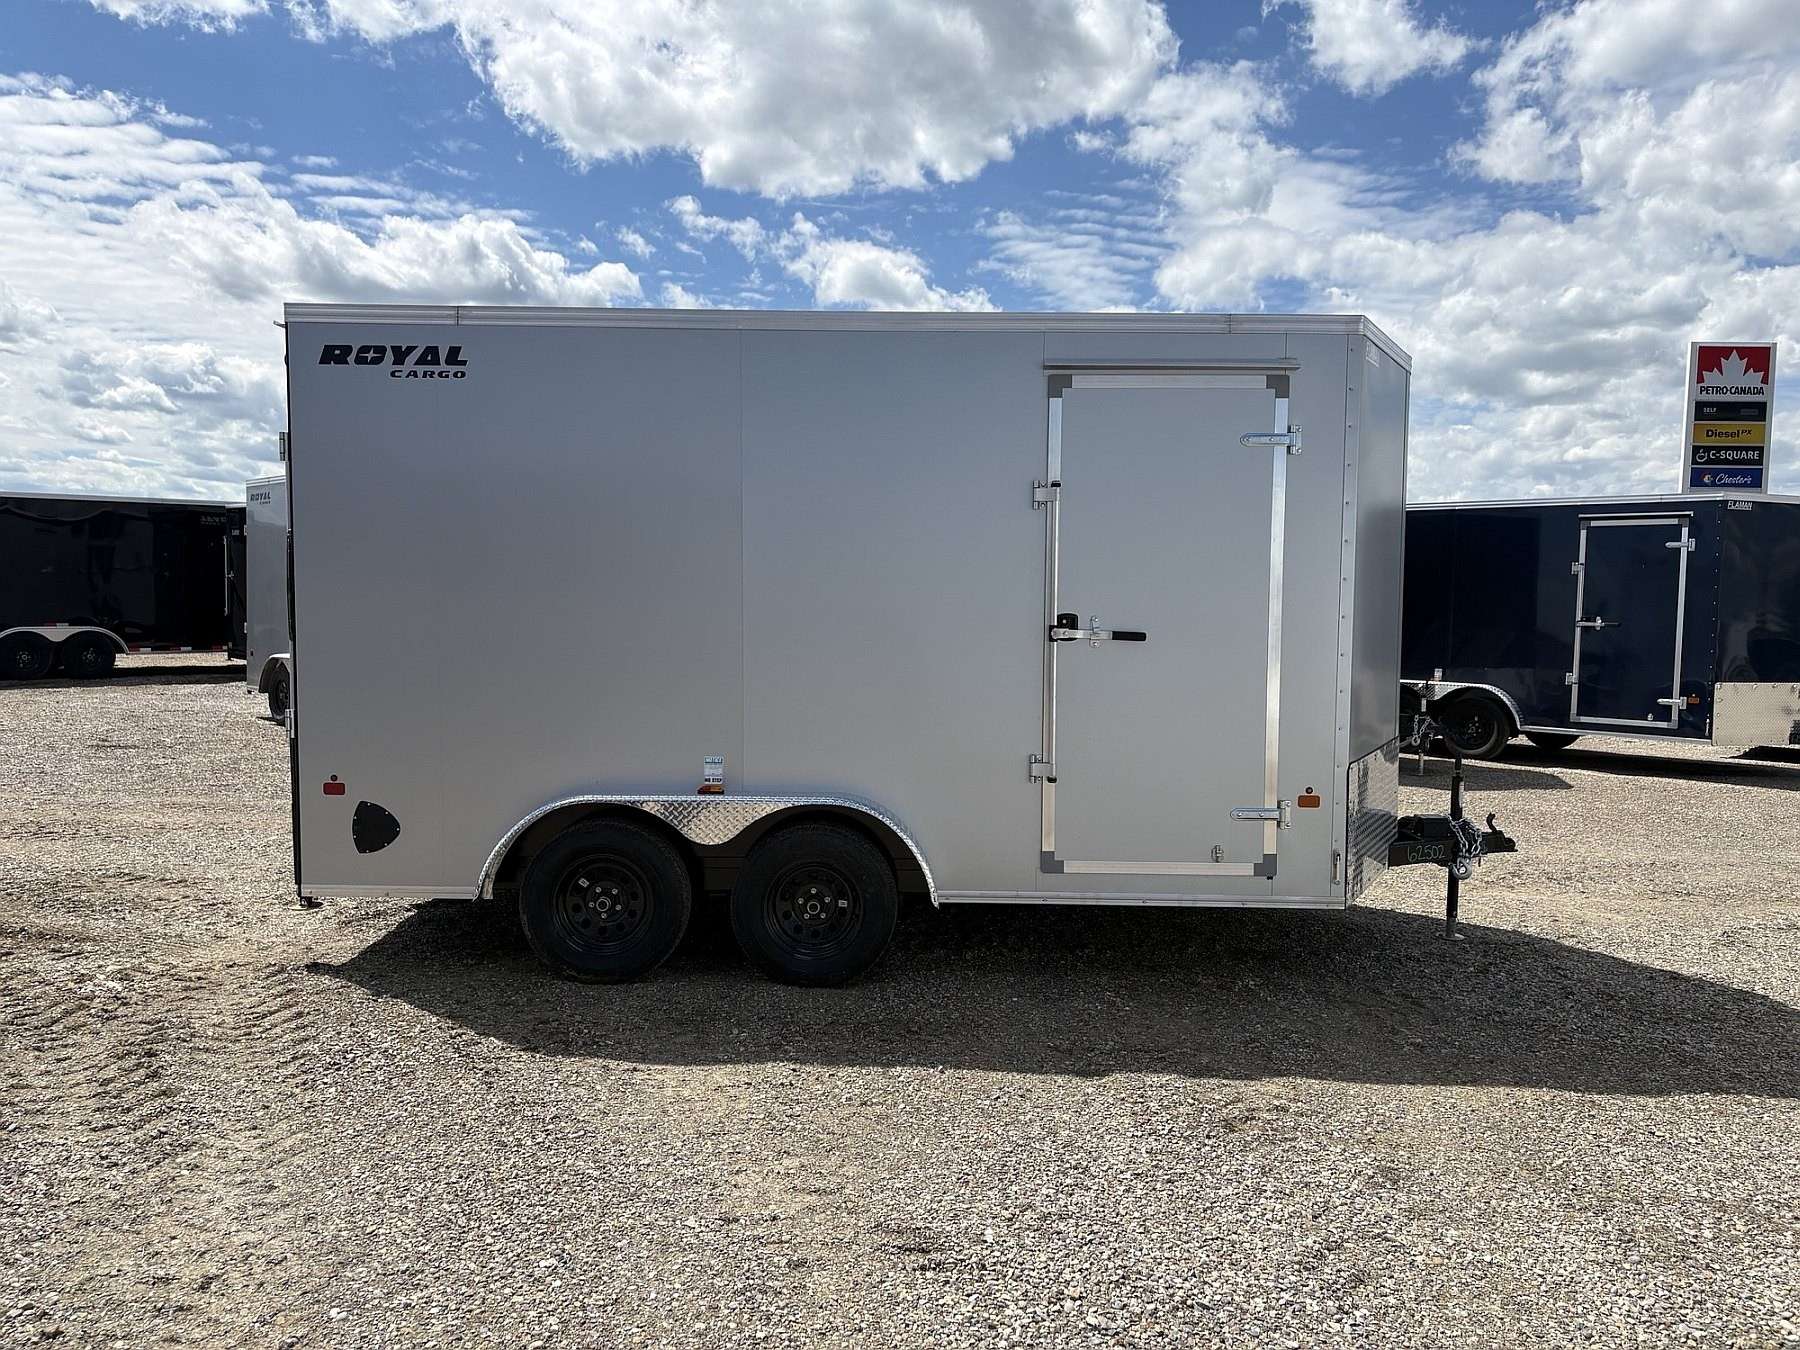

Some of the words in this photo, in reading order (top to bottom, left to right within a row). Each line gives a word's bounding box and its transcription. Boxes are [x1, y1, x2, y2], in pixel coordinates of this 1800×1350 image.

[318, 344, 469, 366] ROYAL
[390, 369, 467, 379] CARGO
[1705, 429, 1740, 439] Diesel
[1709, 450, 1760, 460] C-SQUARE
[1407, 844, 1446, 862] 62502
